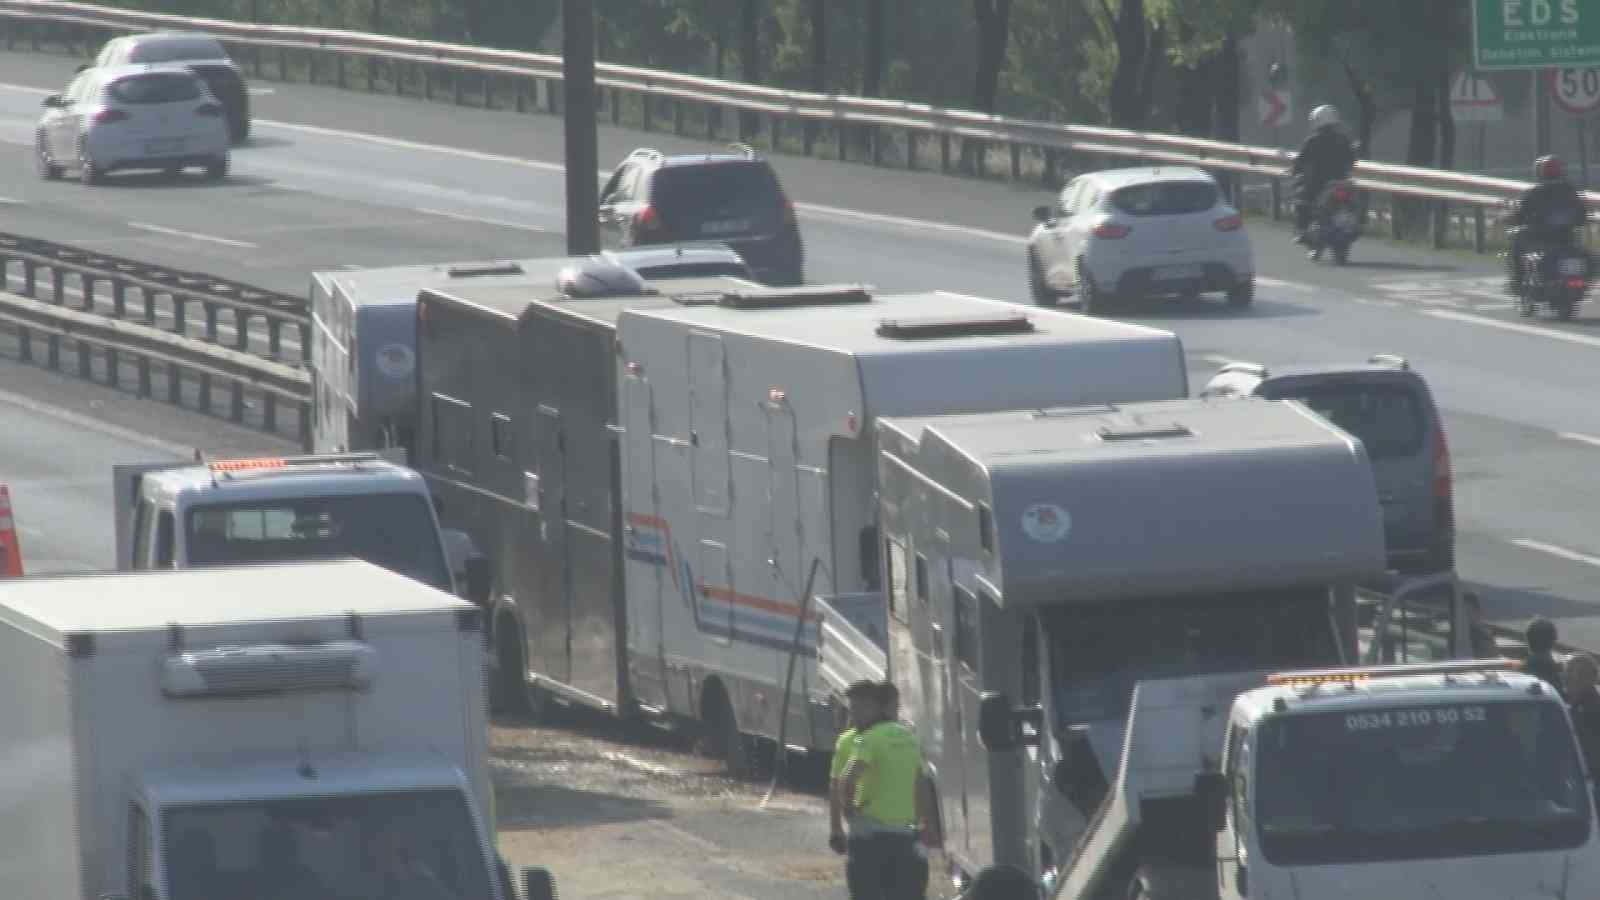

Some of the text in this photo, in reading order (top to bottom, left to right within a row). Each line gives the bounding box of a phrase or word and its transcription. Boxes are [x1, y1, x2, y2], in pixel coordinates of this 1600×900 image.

[1503, 0, 1579, 25] EDS
[1560, 68, 1598, 99] 50
[1345, 713, 1392, 730] 0534
[1396, 709, 1431, 727] 210
[1463, 706, 1487, 721] 52
